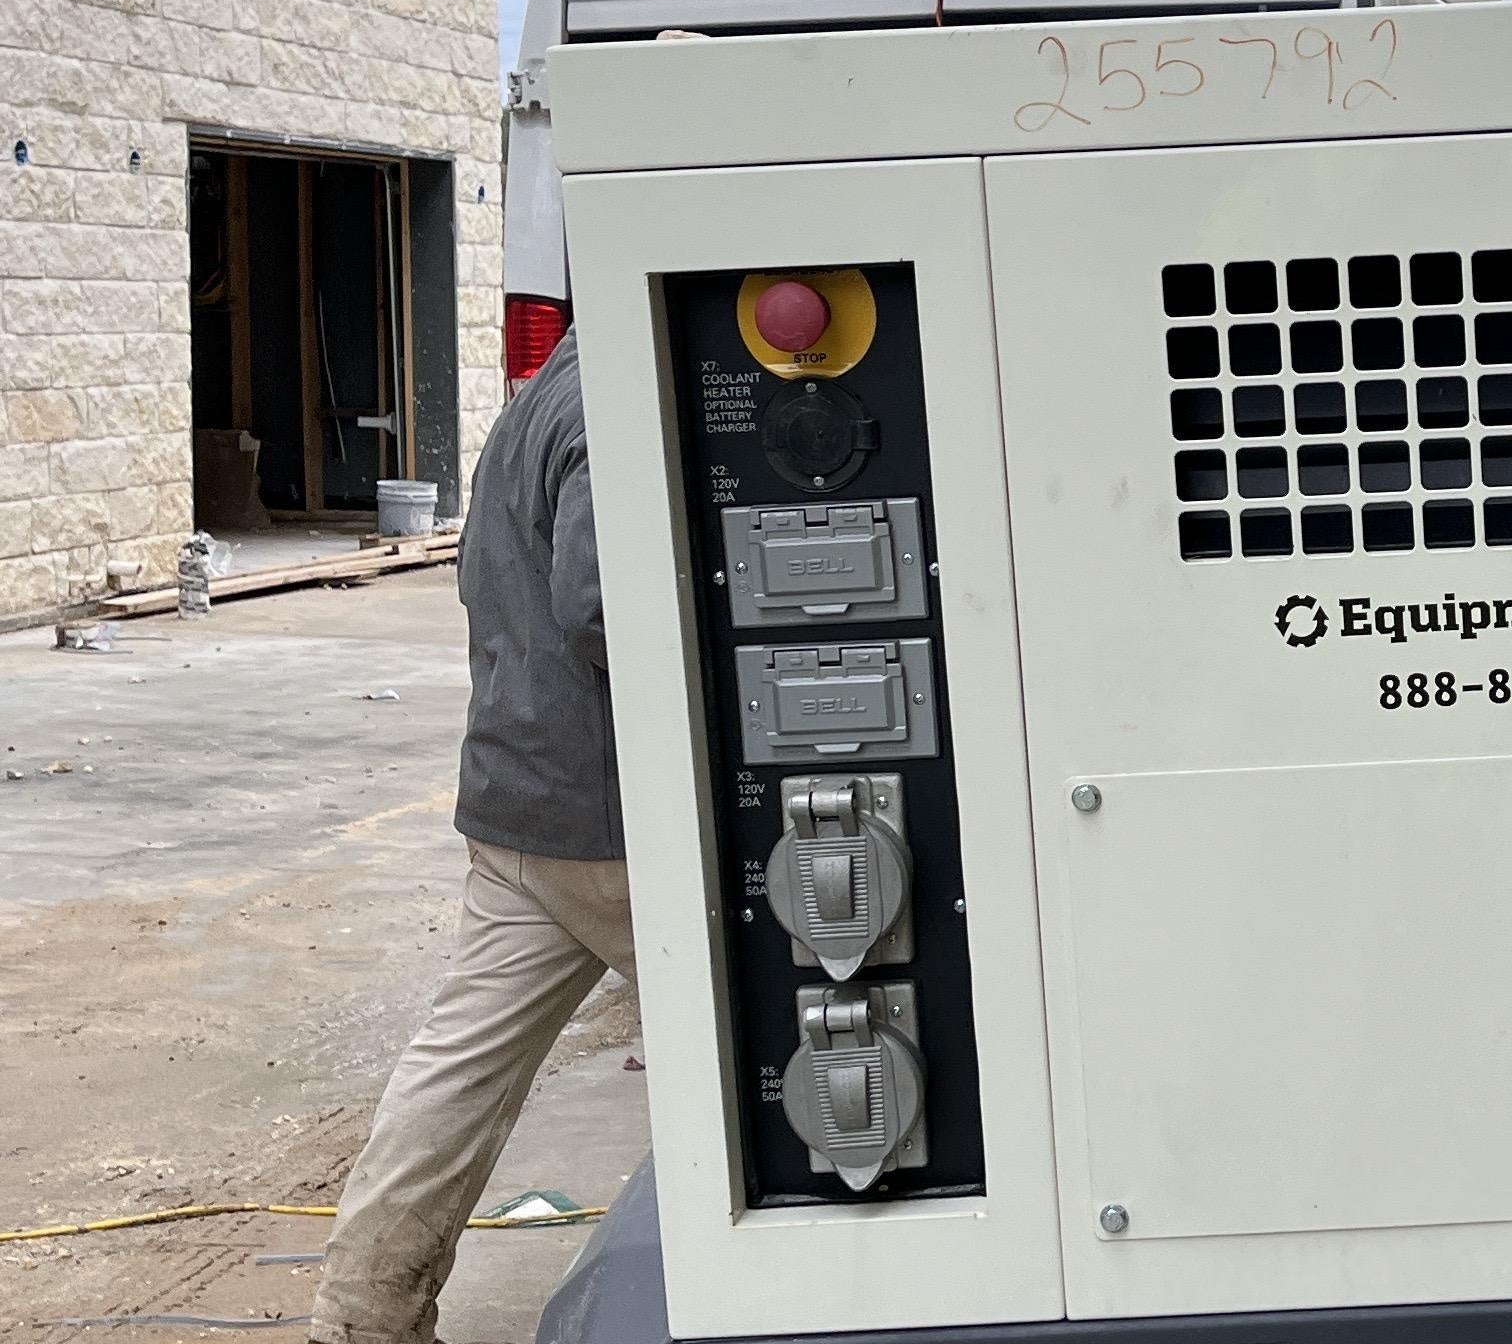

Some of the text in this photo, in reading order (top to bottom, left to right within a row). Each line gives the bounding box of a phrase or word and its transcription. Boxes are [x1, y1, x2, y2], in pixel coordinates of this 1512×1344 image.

[1012, 17, 1398, 133] 255792
[794, 352, 827, 364] STOP
[701, 360, 720, 372] X7:
[701, 372, 761, 385] COOLANT
[703, 386, 751, 399] HEATER
[704, 400, 758, 411] OPTIONAL
[705, 411, 752, 422] BATTERY
[706, 422, 757, 434] CHARGER
[710, 465, 730, 477] X2:
[712, 478, 740, 490] 120V
[712, 491, 736, 503] 20A
[787, 557, 855, 576] BELL
[799, 697, 868, 715] BELL
[736, 771, 755, 782] X3:
[737, 784, 766, 794] 120V
[738, 797, 761, 808] 20A
[744, 860, 762, 870] X4:
[745, 886, 767, 896] 50A
[760, 1066, 779, 1076] X5:
[760, 1078, 784, 1089] 240
